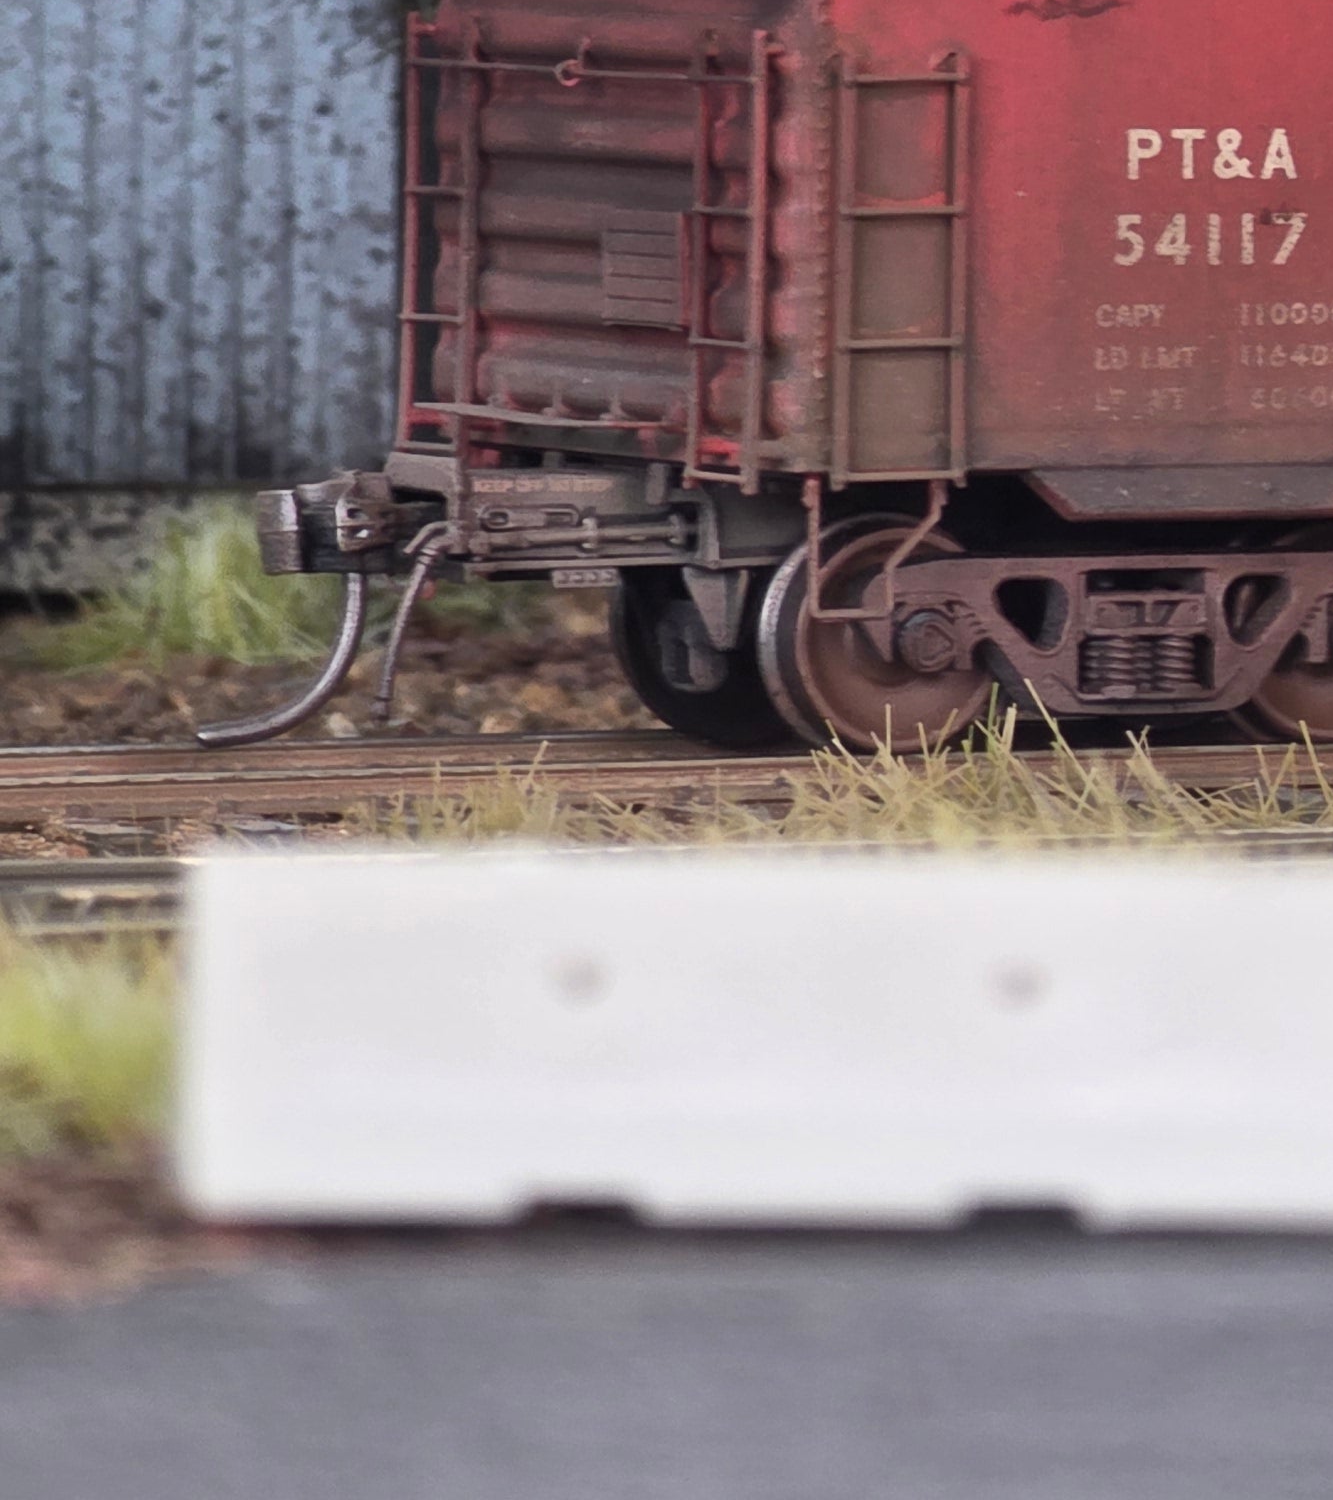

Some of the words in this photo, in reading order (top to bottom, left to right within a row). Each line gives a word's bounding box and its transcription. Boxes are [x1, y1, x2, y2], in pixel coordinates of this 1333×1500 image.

[1125, 127, 1299, 180] PT&A
[1113, 212, 1308, 266] 54117
[1095, 303, 1166, 328] CAPY
